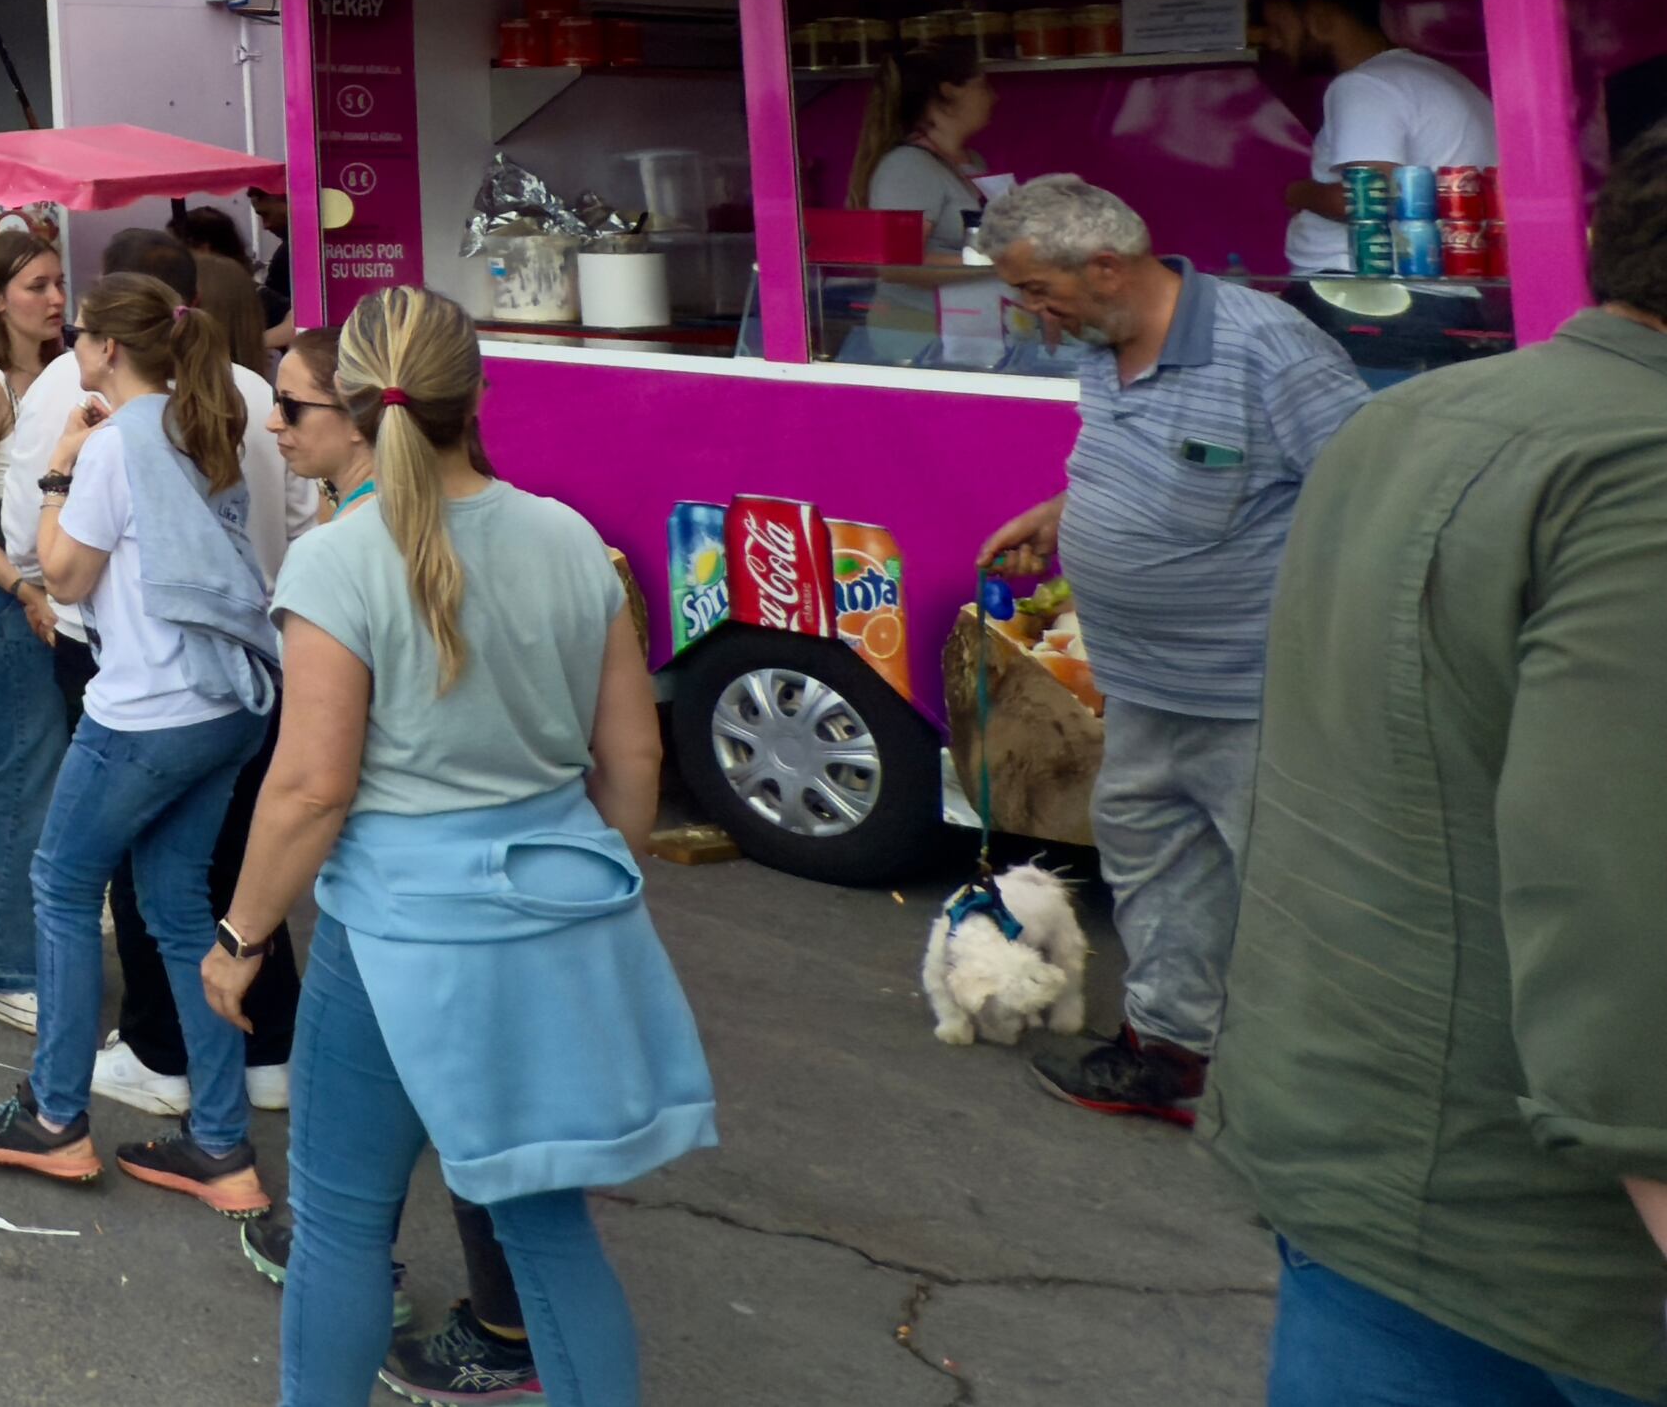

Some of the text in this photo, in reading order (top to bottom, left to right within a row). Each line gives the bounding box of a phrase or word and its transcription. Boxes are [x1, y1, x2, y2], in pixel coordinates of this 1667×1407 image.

[326, 244, 404, 259] RACIAS POR
[331, 262, 395, 278] SU VISITA
